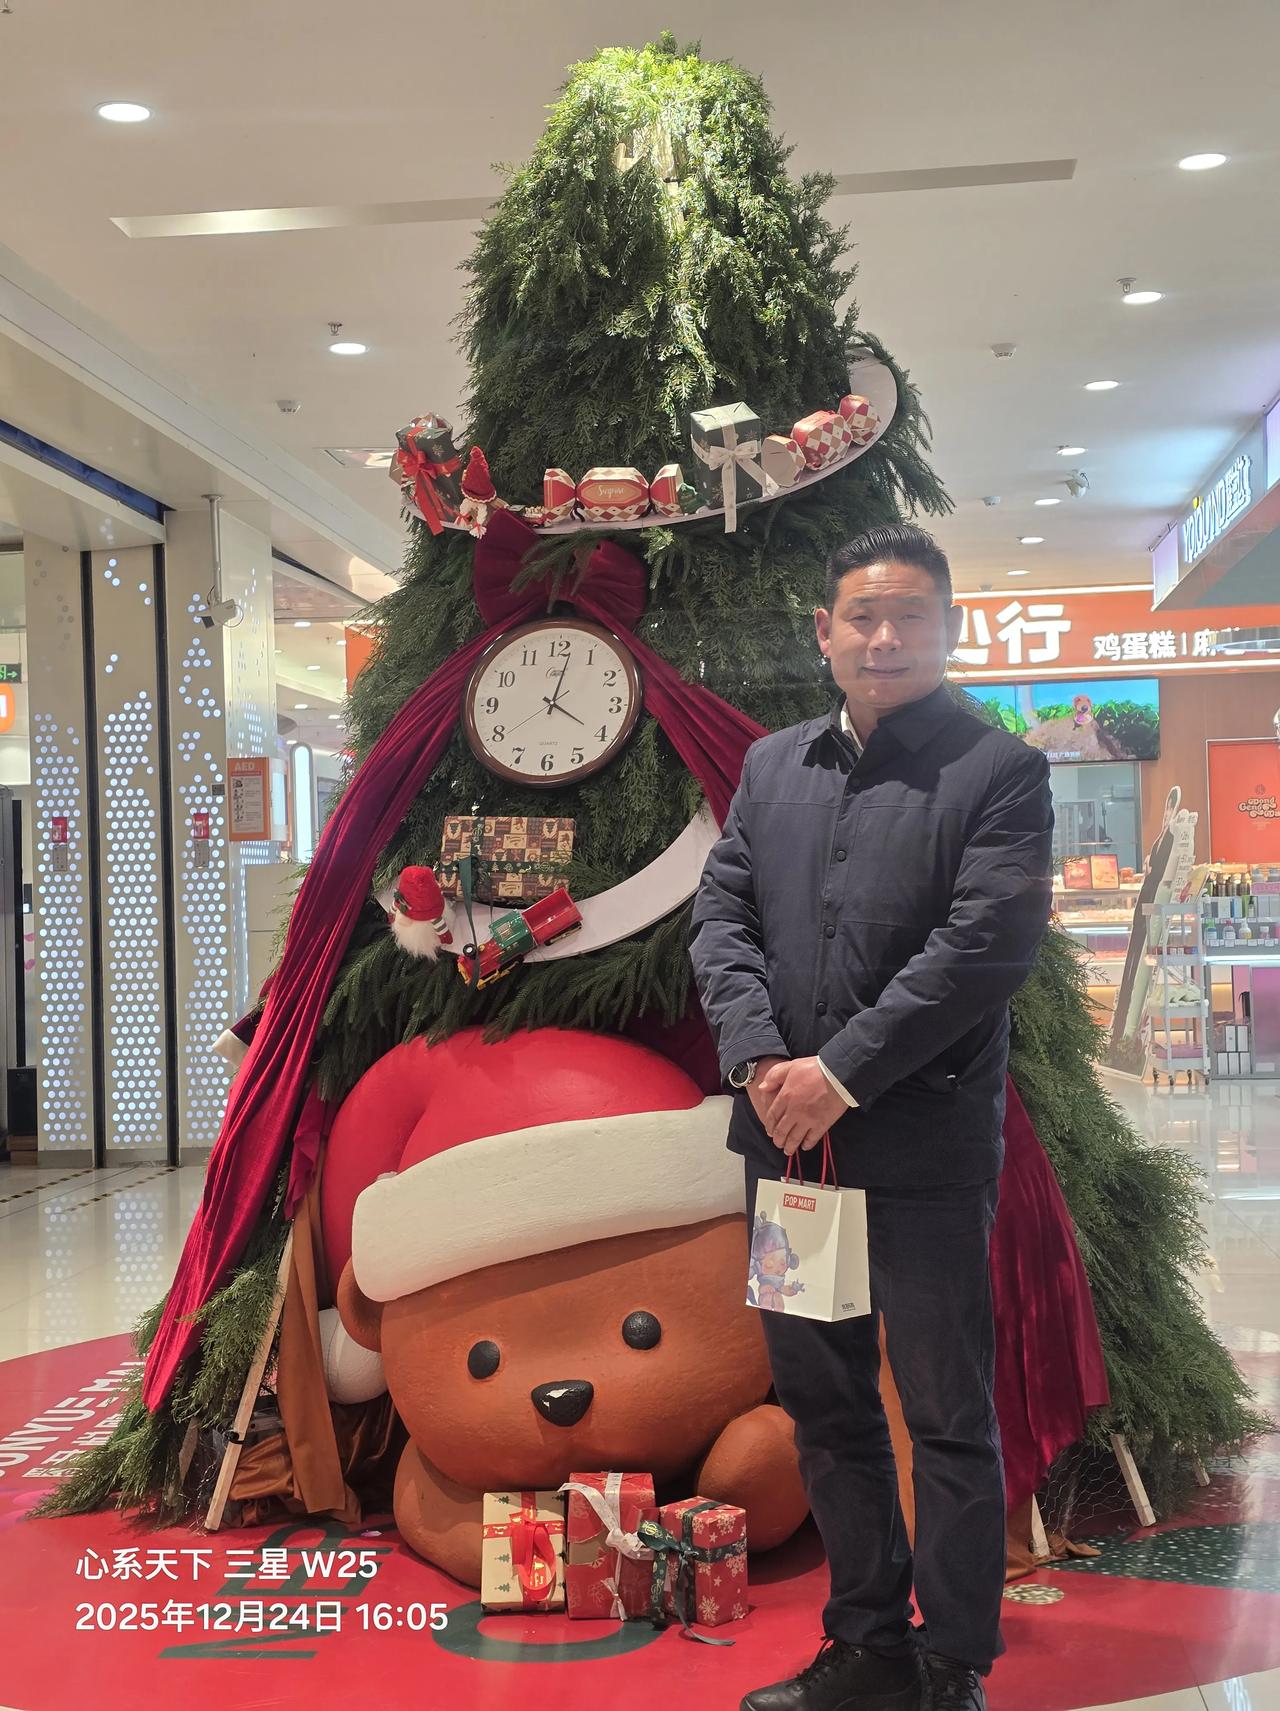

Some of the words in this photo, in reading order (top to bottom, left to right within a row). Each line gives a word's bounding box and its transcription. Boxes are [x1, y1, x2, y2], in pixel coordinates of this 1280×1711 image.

[548, 641, 571, 657] 12
[1093, 630, 1177, 661] 鸡蛋糕
[521, 650, 537, 666] 11
[586, 649, 594, 665] 1
[497, 671, 516, 688] 10
[603, 670, 617, 687] 2
[486, 697, 499, 714] 9
[608, 696, 622, 714] 3
[491, 725, 505, 742] 8
[594, 725, 607, 742] 4
[511, 747, 525, 764] 7
[540, 754, 554, 771] 6
[570, 747, 584, 764] 5
[234, 762, 256, 771] AED
[784, 1195, 799, 1206] POP
[797, 1197, 815, 1210] MART
